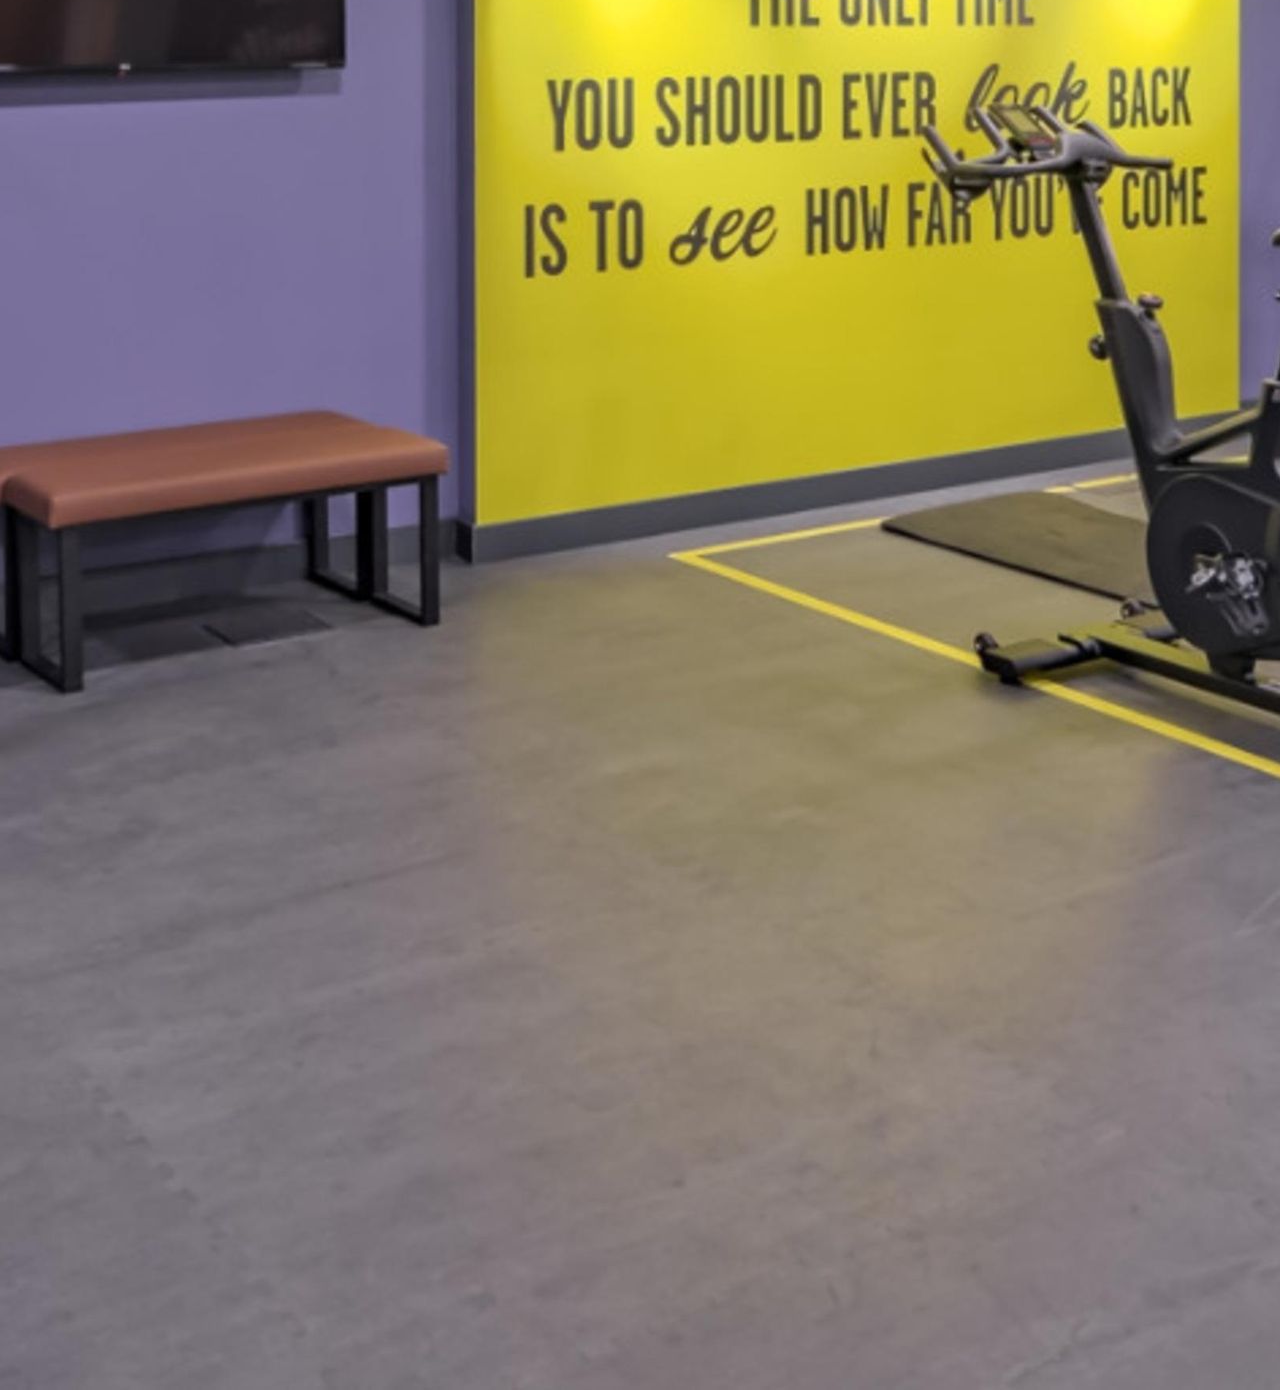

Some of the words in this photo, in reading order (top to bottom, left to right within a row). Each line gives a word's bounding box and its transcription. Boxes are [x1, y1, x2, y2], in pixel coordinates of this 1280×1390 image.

[547, 78, 634, 152] YOU
[656, 74, 822, 147] SHOULD
[842, 71, 937, 140] EVER
[1109, 67, 1192, 128] BACK
[525, 203, 567, 278] IS
[589, 199, 644, 272] TO
[669, 206, 777, 266] see
[806, 183, 890, 256] HOW
[907, 172, 972, 248] FAR
[991, 167, 1104, 242] YOU'
[1122, 166, 1207, 230] COME
